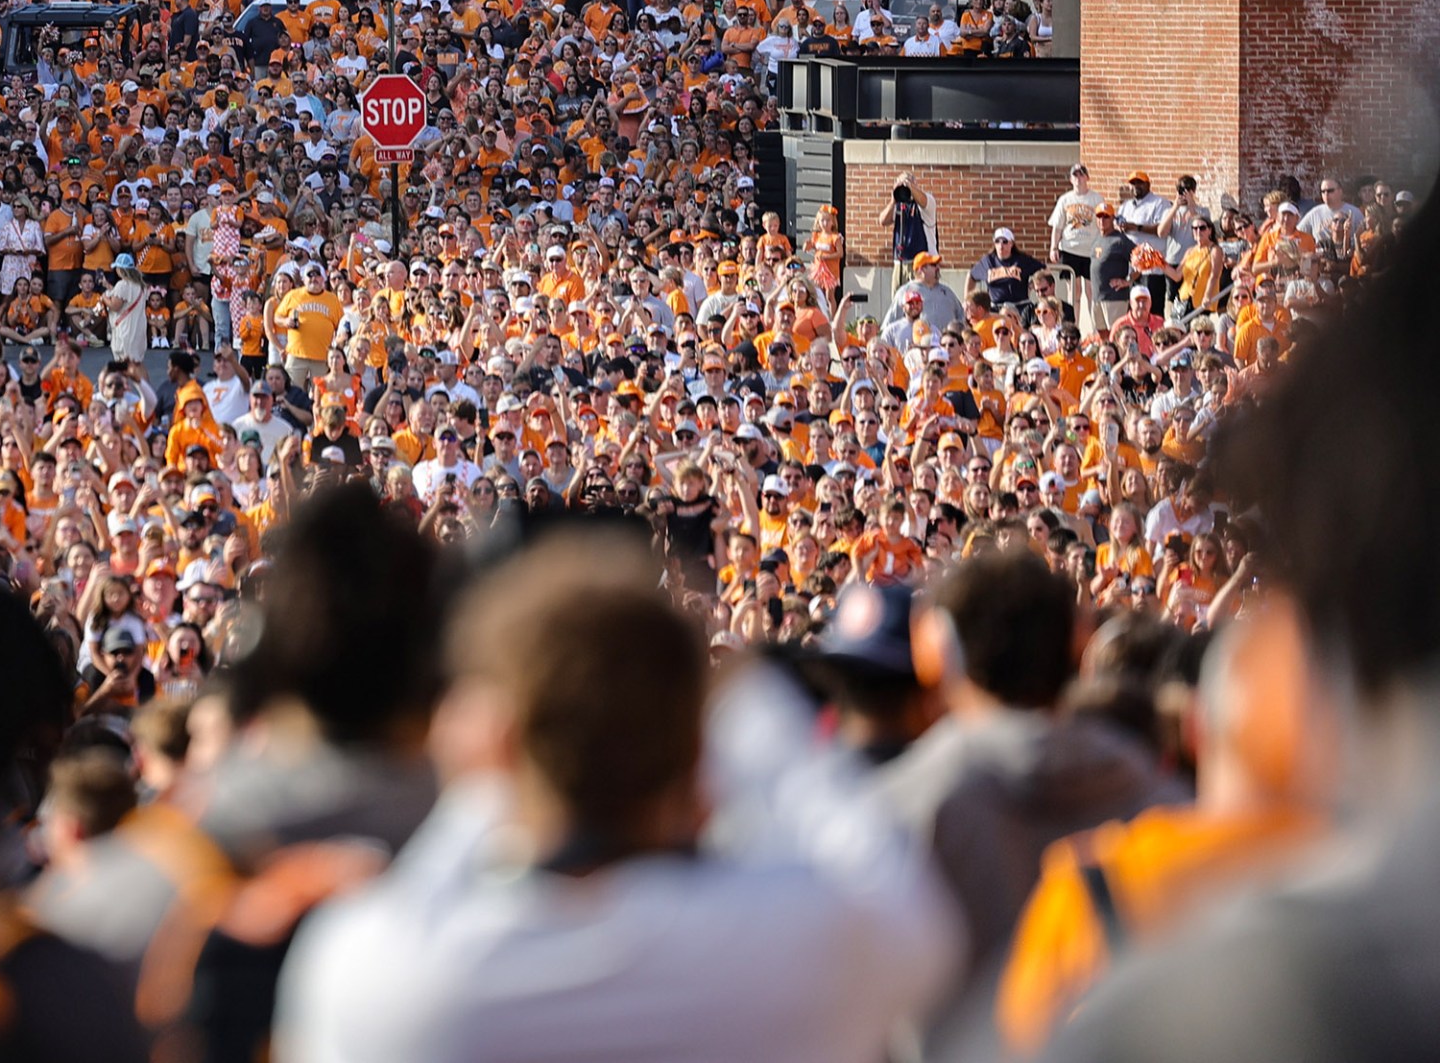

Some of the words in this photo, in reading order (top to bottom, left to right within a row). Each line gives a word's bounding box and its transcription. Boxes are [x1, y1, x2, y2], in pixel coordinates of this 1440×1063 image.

[366, 97, 422, 126] STOP
[377, 150, 391, 160] ALL
[396, 149, 412, 160] WAY
